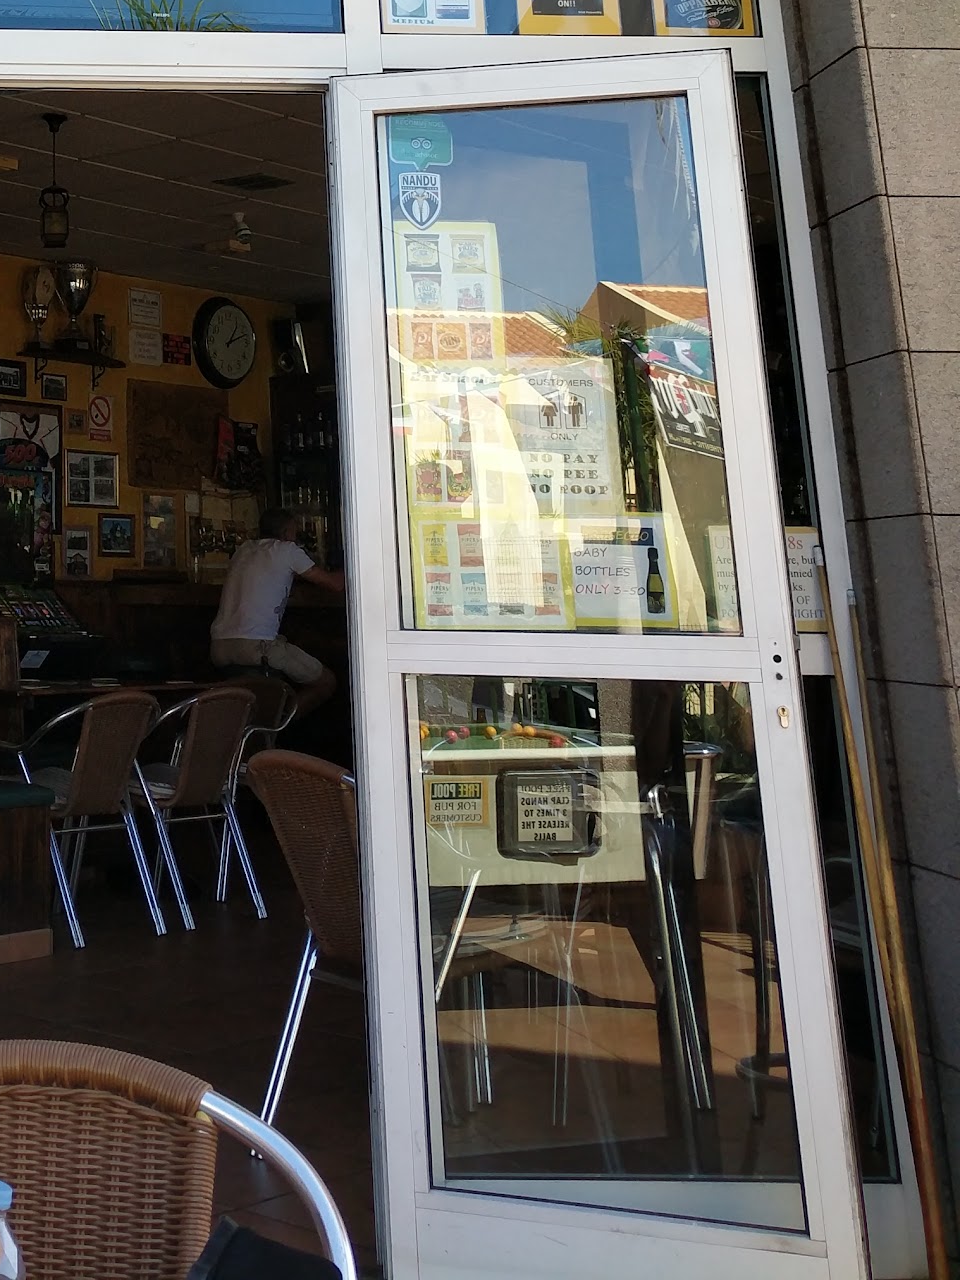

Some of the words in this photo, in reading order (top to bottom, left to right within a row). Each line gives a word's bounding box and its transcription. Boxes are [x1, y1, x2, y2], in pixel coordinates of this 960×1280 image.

[557, 0, 577, 8] ON!!
[401, 175, 437, 187] NANDU
[528, 377, 594, 387] CUSTOMERS
[550, 432, 579, 441] ONLY
[528, 453, 553, 463] NO
[563, 454, 599, 465] PAY
[530, 468, 554, 478] NO
[564, 469, 599, 480] PEE
[528, 483, 551, 494] NO
[560, 484, 609, 495] POOP
[574, 546, 608, 558] BABY
[715, 556, 732, 565] Are
[575, 565, 631, 577] BOTTLES
[575, 583, 610, 595] ONLY
[613, 586, 646, 596] 3-50
[718, 583, 729, 593] by
[796, 595, 811, 605] OF
